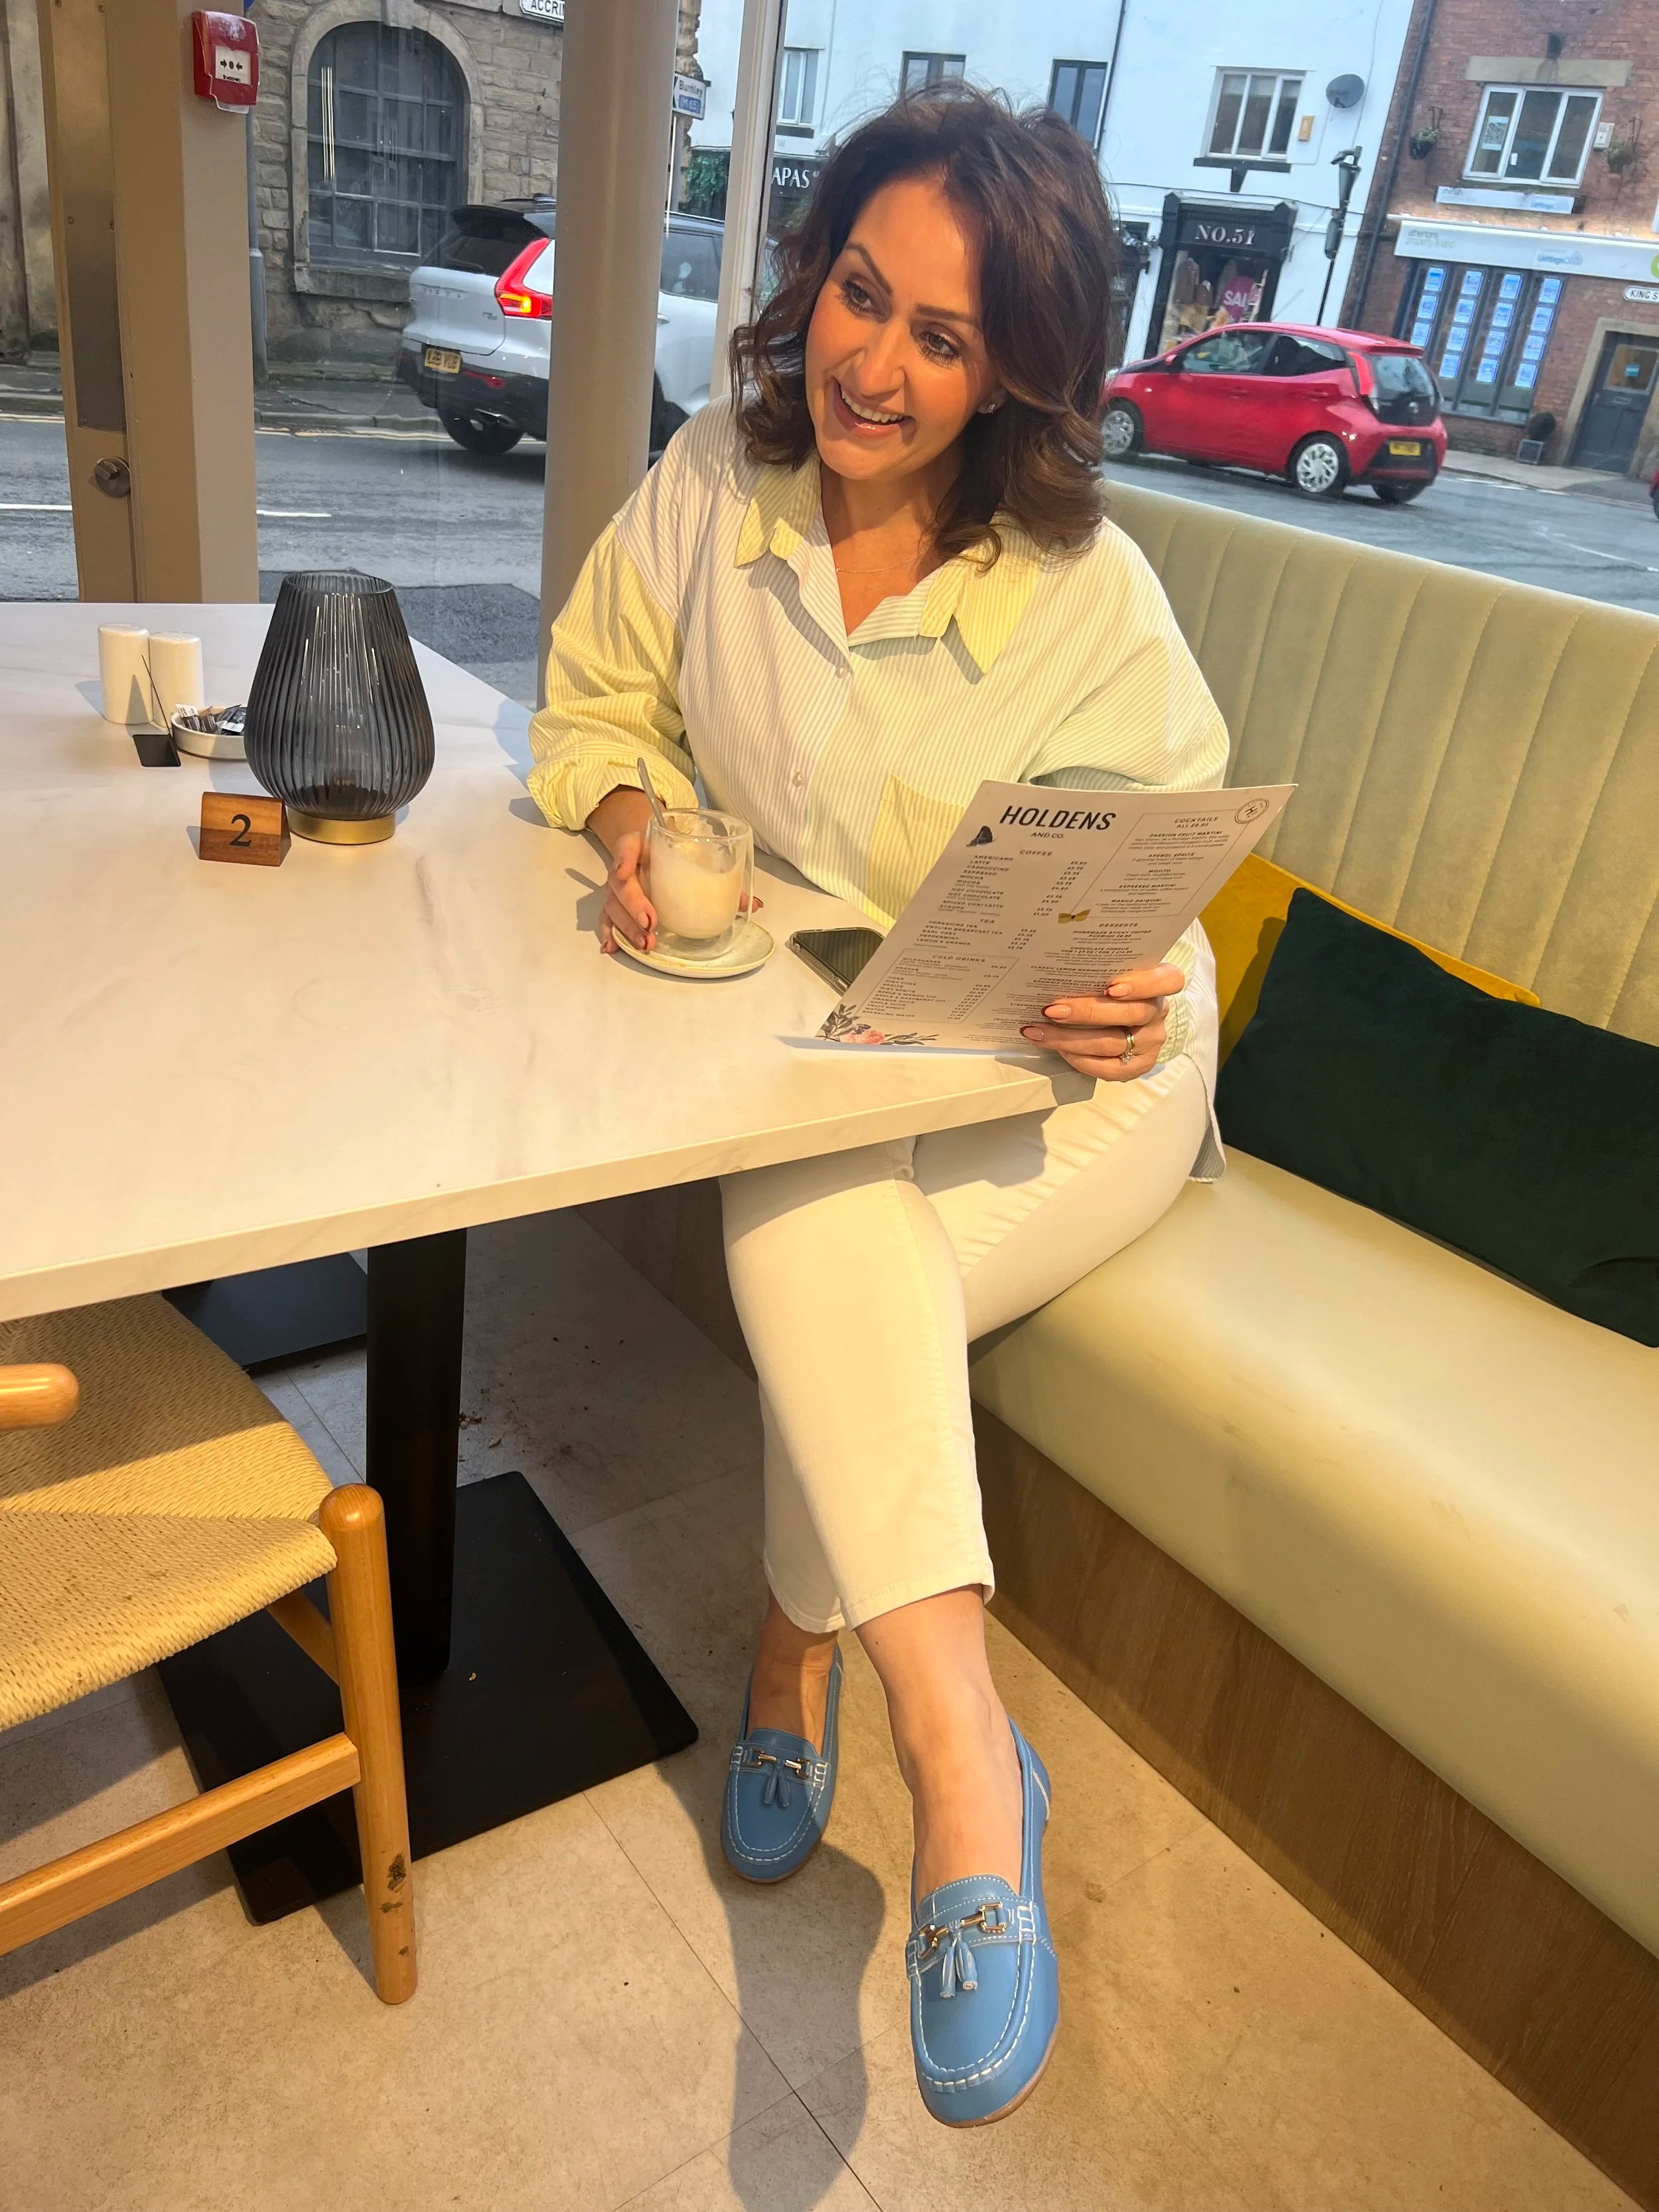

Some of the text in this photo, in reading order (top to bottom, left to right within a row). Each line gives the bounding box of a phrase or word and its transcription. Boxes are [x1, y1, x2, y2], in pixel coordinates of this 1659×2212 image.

[679, 80, 703, 98] Burnley
[771, 166, 810, 188] APAS
[1195, 224, 1256, 246] NO.51
[1223, 291, 1248, 309] SAL
[1630, 289, 1650, 299] KING
[999, 806, 1116, 831] HOLDENS
[229, 814, 252, 848] 2
